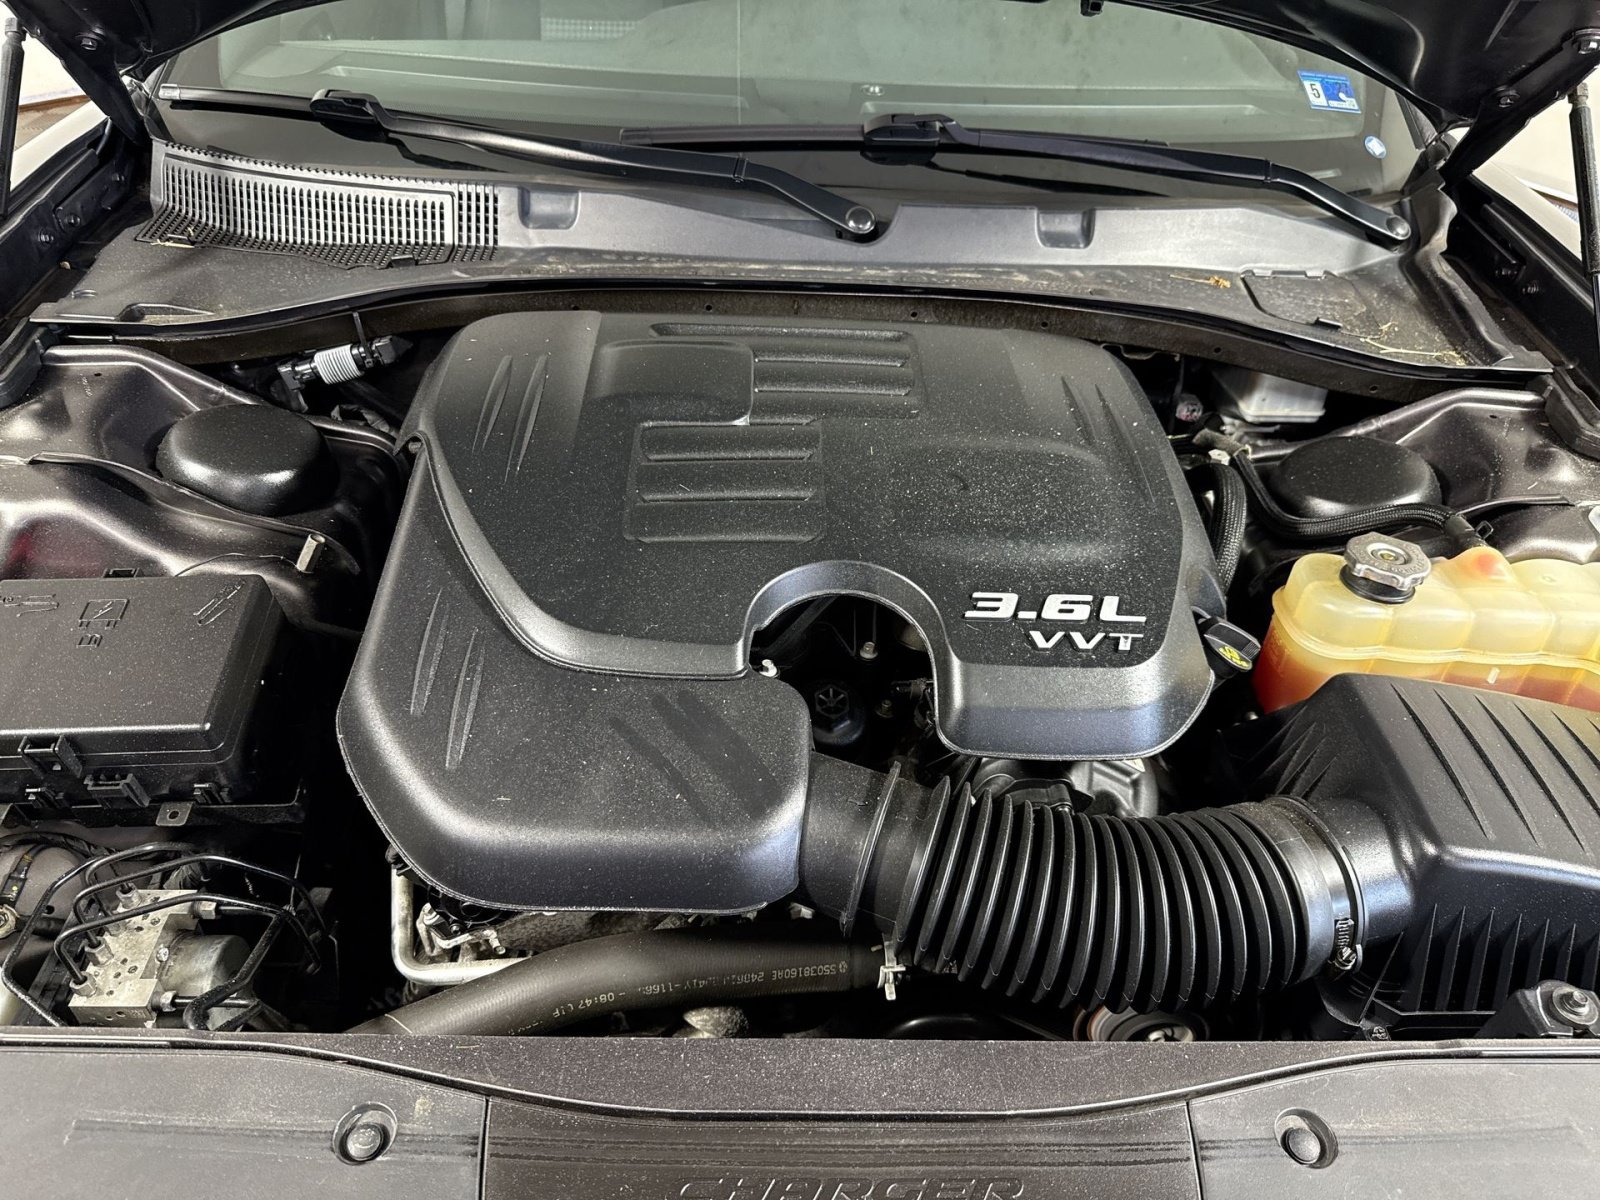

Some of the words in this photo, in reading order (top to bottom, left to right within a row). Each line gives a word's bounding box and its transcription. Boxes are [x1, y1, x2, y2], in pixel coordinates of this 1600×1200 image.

[1310, 83, 1321, 98] 5
[964, 591, 1147, 623] 3.6L
[1029, 630, 1145, 651] VVT
[771, 964, 837, 981] 55038160AE
[578, 992, 615, 1009] 08:47
[667, 1177, 1026, 1200] CHARGER
